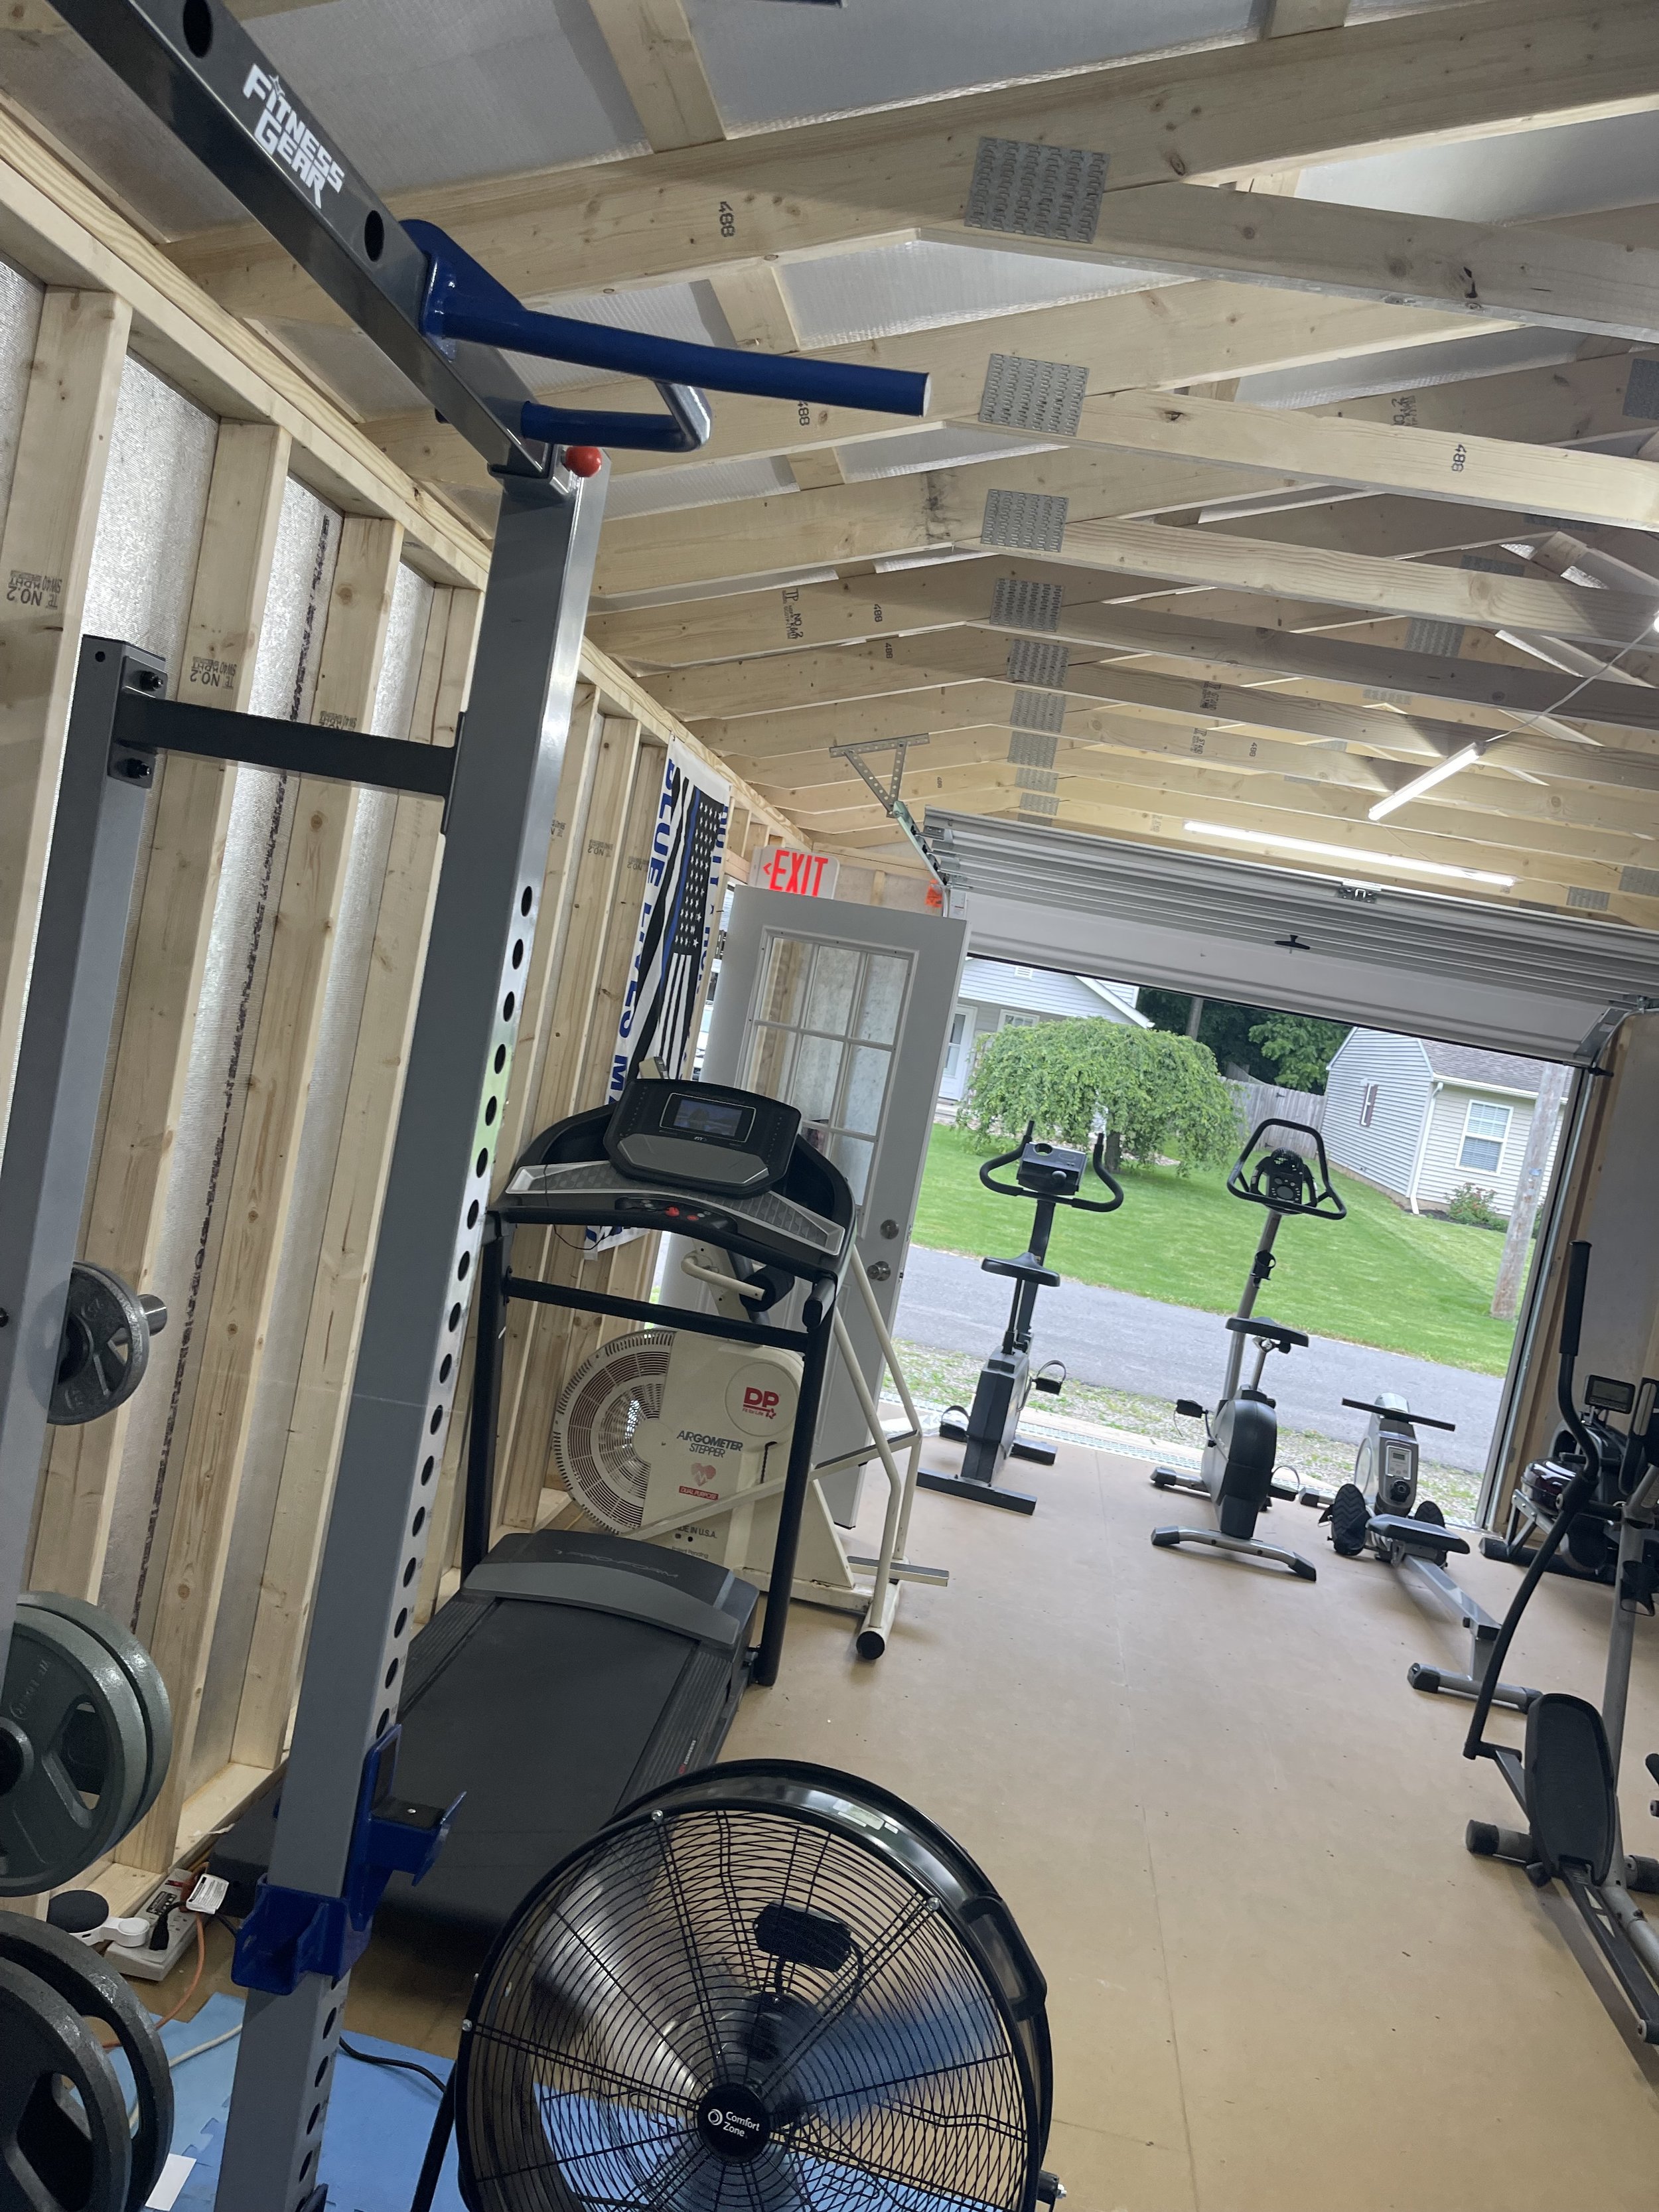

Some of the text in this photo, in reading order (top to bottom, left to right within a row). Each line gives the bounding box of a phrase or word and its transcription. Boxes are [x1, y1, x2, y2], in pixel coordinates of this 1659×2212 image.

[243, 62, 346, 194] FITNESS
[253, 108, 323, 209] GEAR
[719, 201, 735, 238] 488
[1451, 444, 1467, 473] 488
[6, 585, 43, 607] NO.2
[873, 603, 883, 623] 488
[885, 642, 893, 659] 488
[190, 669, 220, 688] NO.2
[768, 849, 829, 897] EXIT
[744, 1386, 780, 1408] DP
[689, 1443, 725, 1458] STEPPER
[723, 2121, 745, 2137] Zone
[725, 2111, 760, 2132] Comfort
